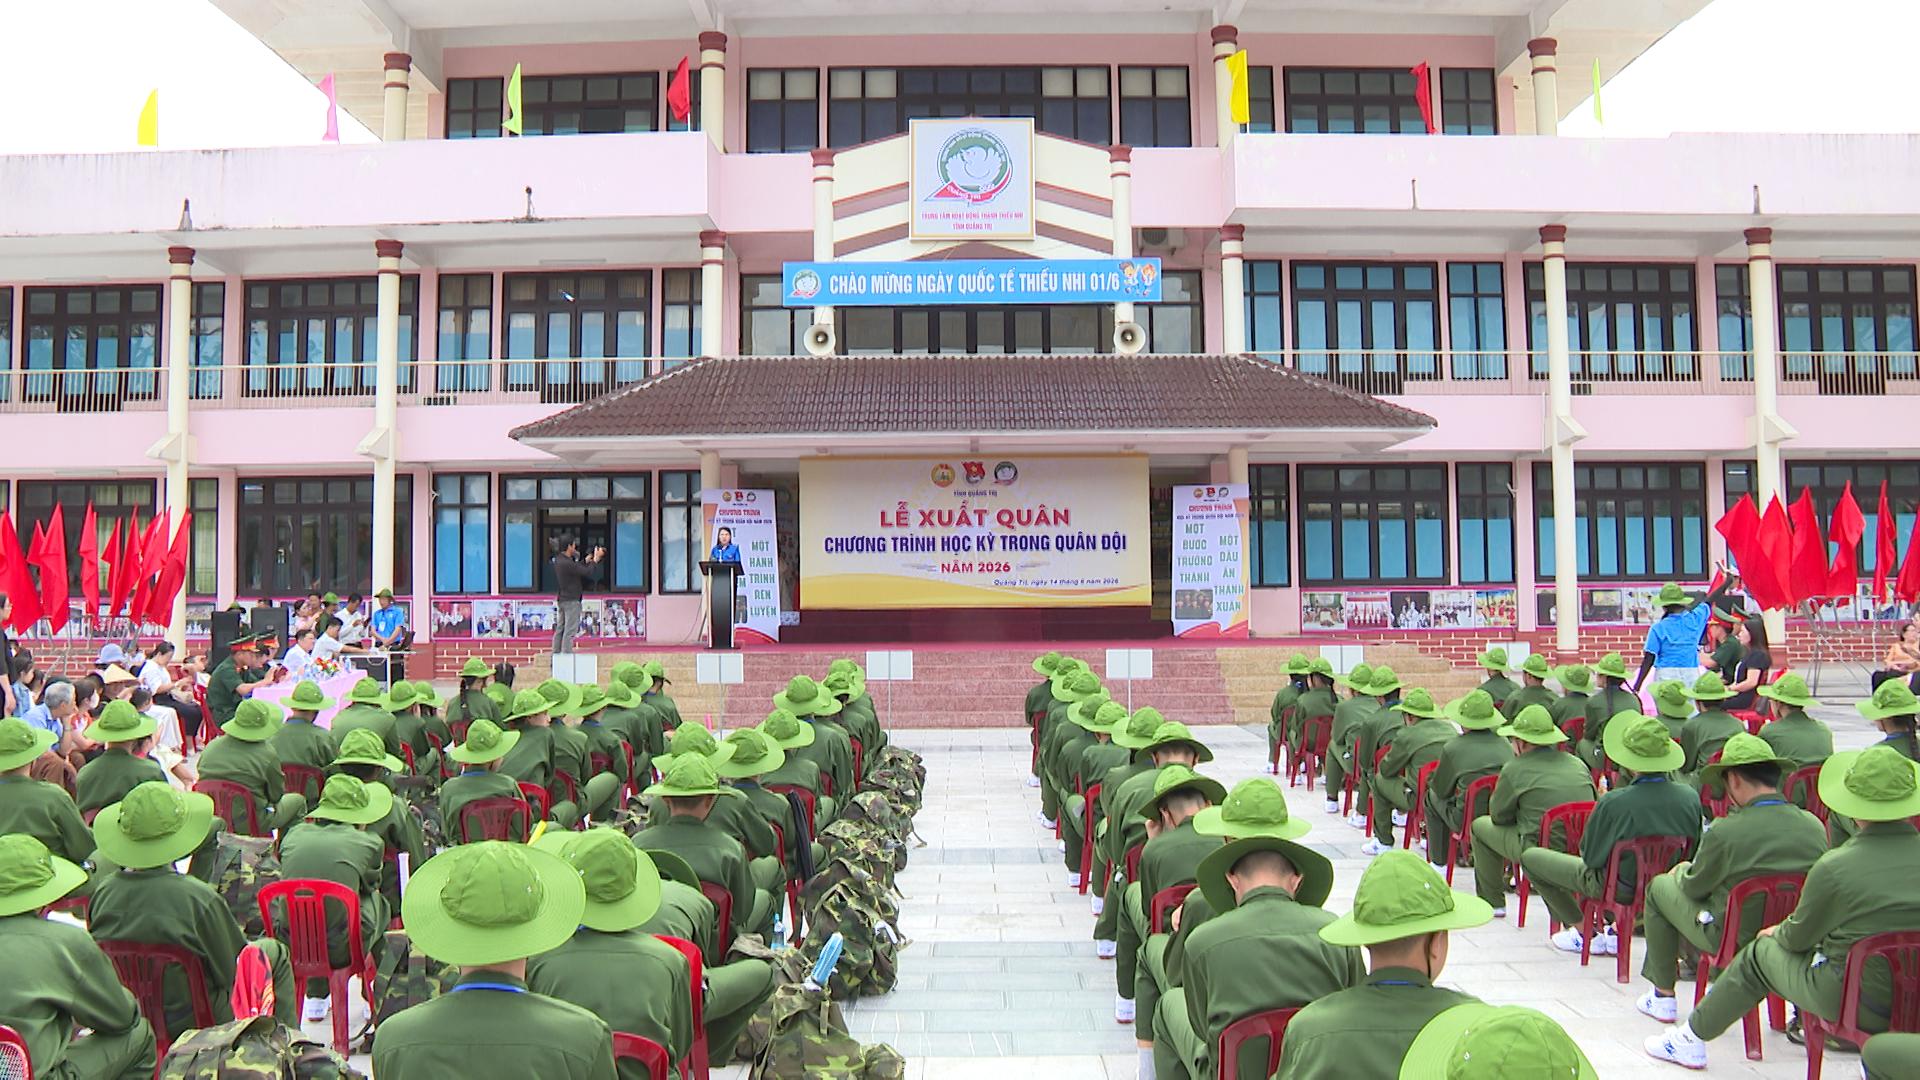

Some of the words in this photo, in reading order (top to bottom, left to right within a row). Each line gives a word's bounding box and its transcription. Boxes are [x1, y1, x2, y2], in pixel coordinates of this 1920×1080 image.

[829, 271, 867, 295] CHÀO
[871, 271, 913, 295] MỪNG
[917, 270, 954, 294] NGÀY
[958, 266, 995, 294] QUỐC
[1000, 267, 1016, 293] TẾ
[1019, 267, 1058, 292] THIẾU
[1062, 272, 1086, 292] NHI
[1090, 271, 1120, 292] 01/6
[880, 501, 910, 528] LỄ
[918, 500, 988, 528] XUẤT
[996, 503, 1071, 530] QUÂN
[824, 535, 886, 554] CHƯƠNG
[891, 533, 936, 553] TRÌNH
[941, 535, 971, 556] HỌC
[976, 531, 996, 552] KỲ
[1000, 535, 1050, 552] TRONG
[1055, 531, 1097, 553] QUÂN
[1101, 531, 1127, 554] ĐỘI
[941, 559, 973, 574] NĂM
[978, 561, 1011, 573] 2026
